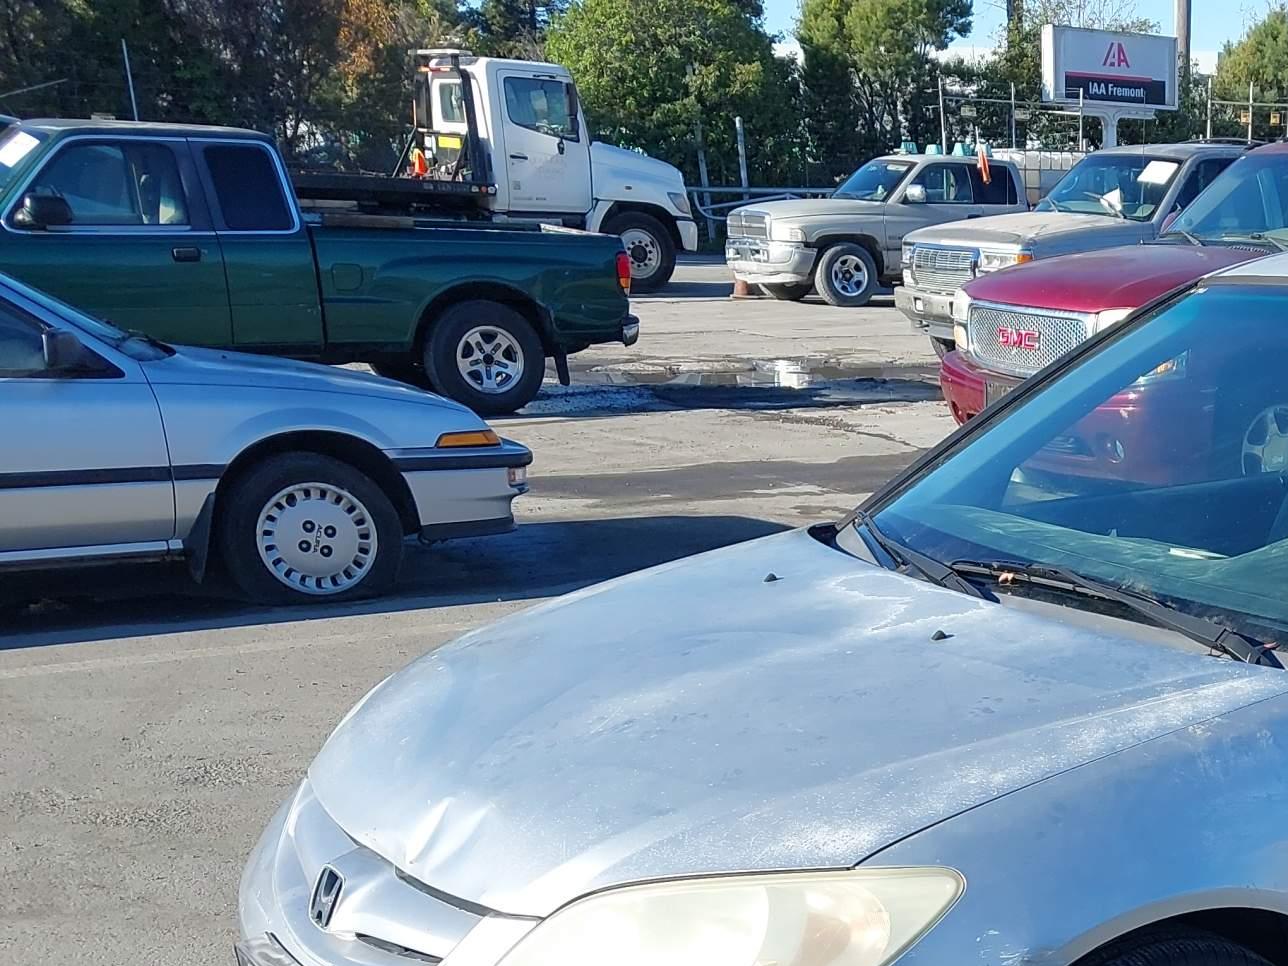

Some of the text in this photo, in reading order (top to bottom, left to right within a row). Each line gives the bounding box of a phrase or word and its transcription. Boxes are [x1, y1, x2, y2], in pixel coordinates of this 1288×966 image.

[1088, 81, 1144, 98] IAA Fremont
[999, 326, 1040, 349] GMC
[312, 523, 323, 554] ACURA
